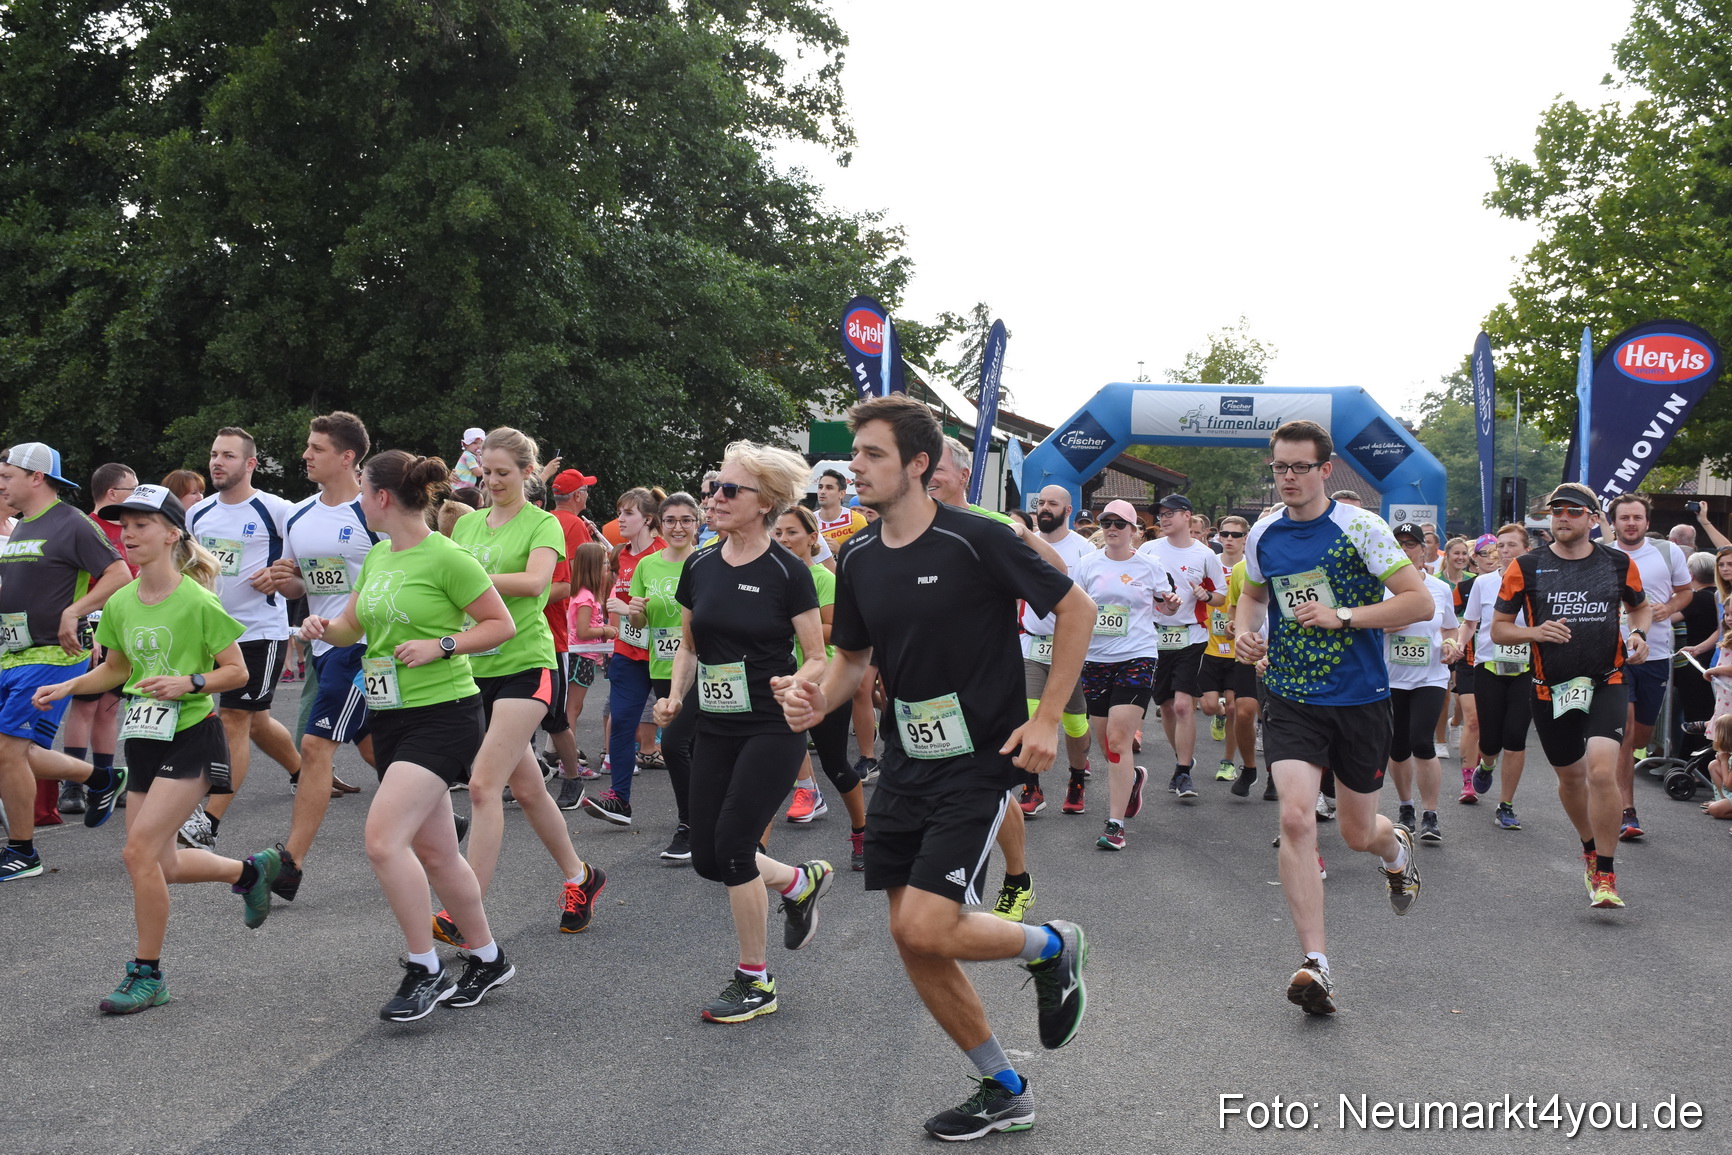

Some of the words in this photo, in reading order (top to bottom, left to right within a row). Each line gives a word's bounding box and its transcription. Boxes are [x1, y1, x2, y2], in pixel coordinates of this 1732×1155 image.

[1625, 344, 1704, 373] Hervis
[1207, 416, 1282, 430] firmenlauf
[1067, 434, 1107, 446] Fischer
[1591, 392, 1688, 530] ETMOVIN
[831, 528, 854, 539] BÖGL
[308, 570, 344, 585] 1882
[918, 576, 938, 584] PHILIPP
[738, 584, 760, 592] THERESIA
[1285, 588, 1318, 608] 256
[1547, 591, 1588, 603] HECK
[1552, 602, 1609, 615] DESIGN
[624, 624, 642, 639] 595
[1162, 632, 1182, 643] 372
[1394, 645, 1425, 658] 1335
[1498, 645, 1528, 656] 1354
[702, 681, 734, 700] 953
[1558, 688, 1588, 706] 1021
[125, 706, 170, 726] 2417
[907, 720, 946, 744] 951
[945, 874, 967, 888] adidas
